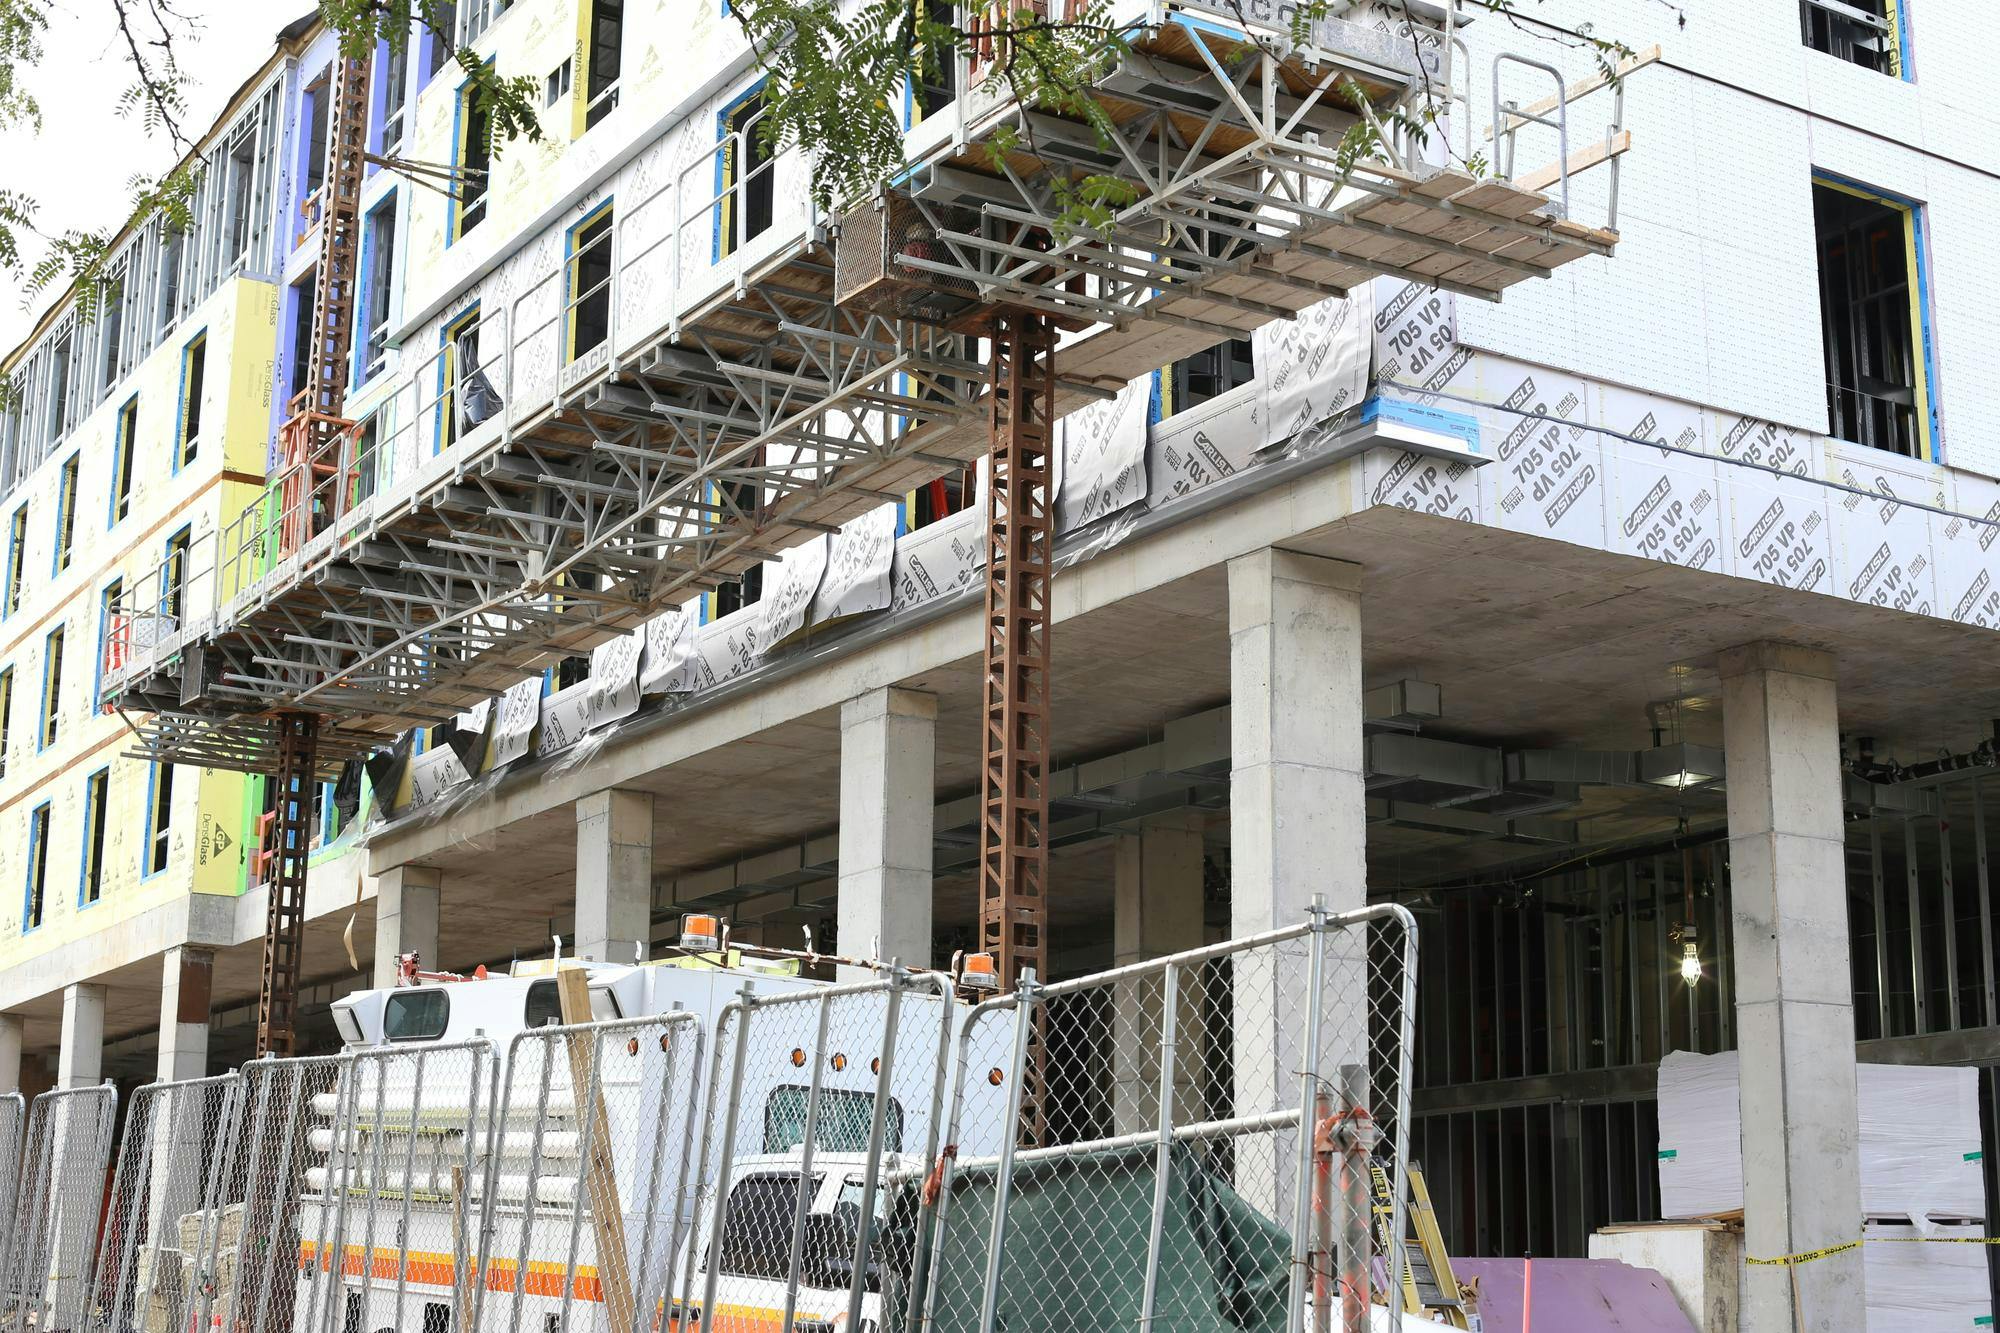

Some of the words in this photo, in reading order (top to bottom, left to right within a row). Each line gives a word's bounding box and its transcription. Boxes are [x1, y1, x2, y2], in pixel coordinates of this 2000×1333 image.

[1886, 9, 1899, 77] DensGla
[573, 38, 584, 101] DensGlass
[270, 284, 280, 326] ensGlass
[1314, 298, 1332, 326] 05
[1374, 281, 1430, 333] CARLISL
[1298, 332, 1318, 363] VP
[1388, 320, 1422, 356] 705
[1417, 298, 1441, 326] VP
[1430, 324, 1452, 352] 05
[562, 344, 609, 388] FRACO
[1410, 346, 1434, 375] VP
[262, 359, 274, 408] DensGlass
[1503, 376, 1536, 410] ISLE
[1193, 430, 1236, 477] CARLISLE
[1498, 411, 1541, 461] CARLIS
[1512, 448, 1543, 484] 705
[1539, 425, 1561, 453] VP
[1721, 416, 1758, 455] CARLI
[1739, 443, 1762, 465] 05
[1757, 423, 1778, 448] VP
[1371, 452, 1423, 506] CARLISL
[1412, 466, 1437, 496] VP
[1450, 463, 1469, 482] RESIS
[1550, 443, 1582, 479] 705
[1532, 473, 1556, 502] VP
[1544, 464, 1596, 528] CARLISLE
[1623, 474, 1672, 537] CARLISLE
[1637, 523, 1666, 559] 705
[1661, 500, 1682, 527] VP
[1673, 517, 1702, 551] 705
[1740, 497, 1784, 558] CARLISLE
[1753, 544, 1780, 578] 705
[1775, 521, 1796, 549] VP
[1787, 538, 1813, 572] 705
[1850, 541, 1891, 600] CARLISLE
[900, 572, 916, 600] 705
[909, 554, 940, 597] CARLISLE
[1883, 565, 1902, 591] VP
[1952, 568, 1990, 622] CARLISLE
[199, 813, 213, 867] DensGlass
[215, 830, 227, 852] GP
[1783, 1252, 1819, 1264] CAUTIN
